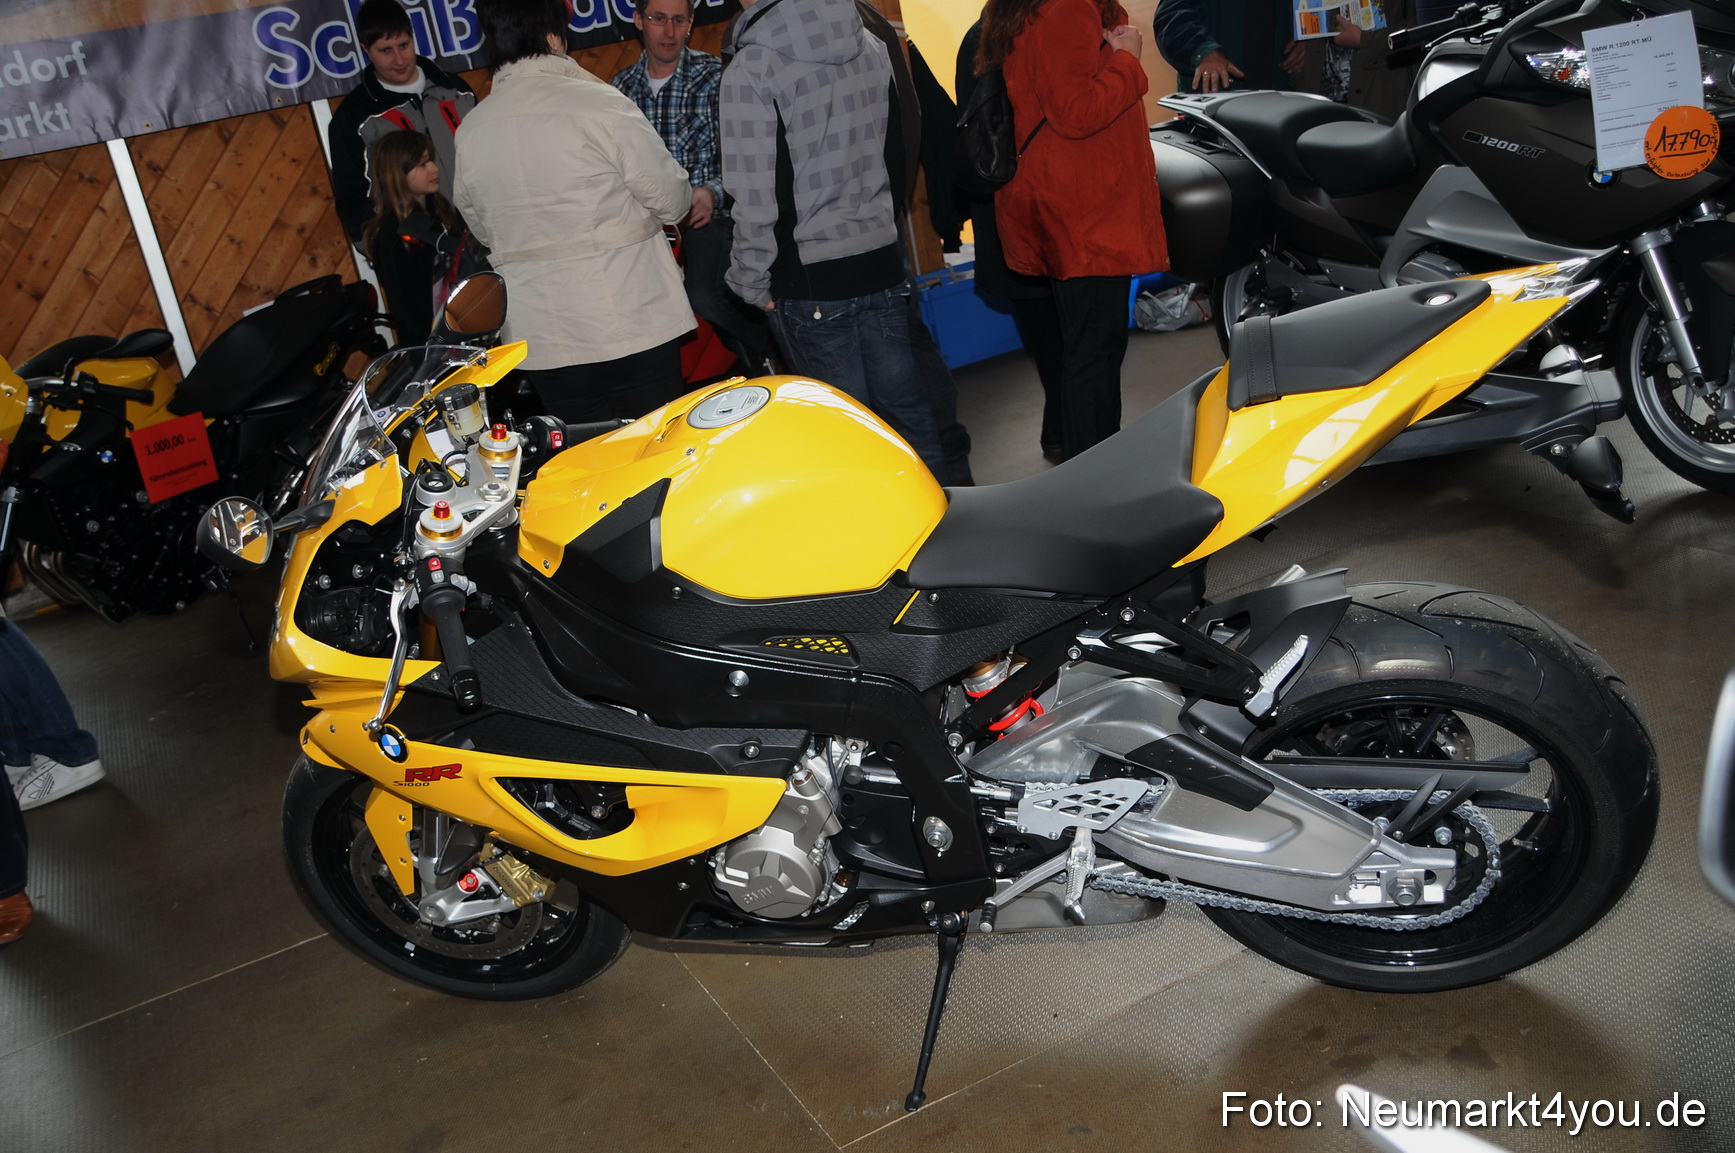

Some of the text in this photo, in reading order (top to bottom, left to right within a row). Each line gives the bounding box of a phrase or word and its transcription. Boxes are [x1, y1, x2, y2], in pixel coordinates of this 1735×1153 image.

[0, 41, 87, 88] dorf
[145, 433, 184, 456] 1.000,00
[405, 763, 464, 782] RR
